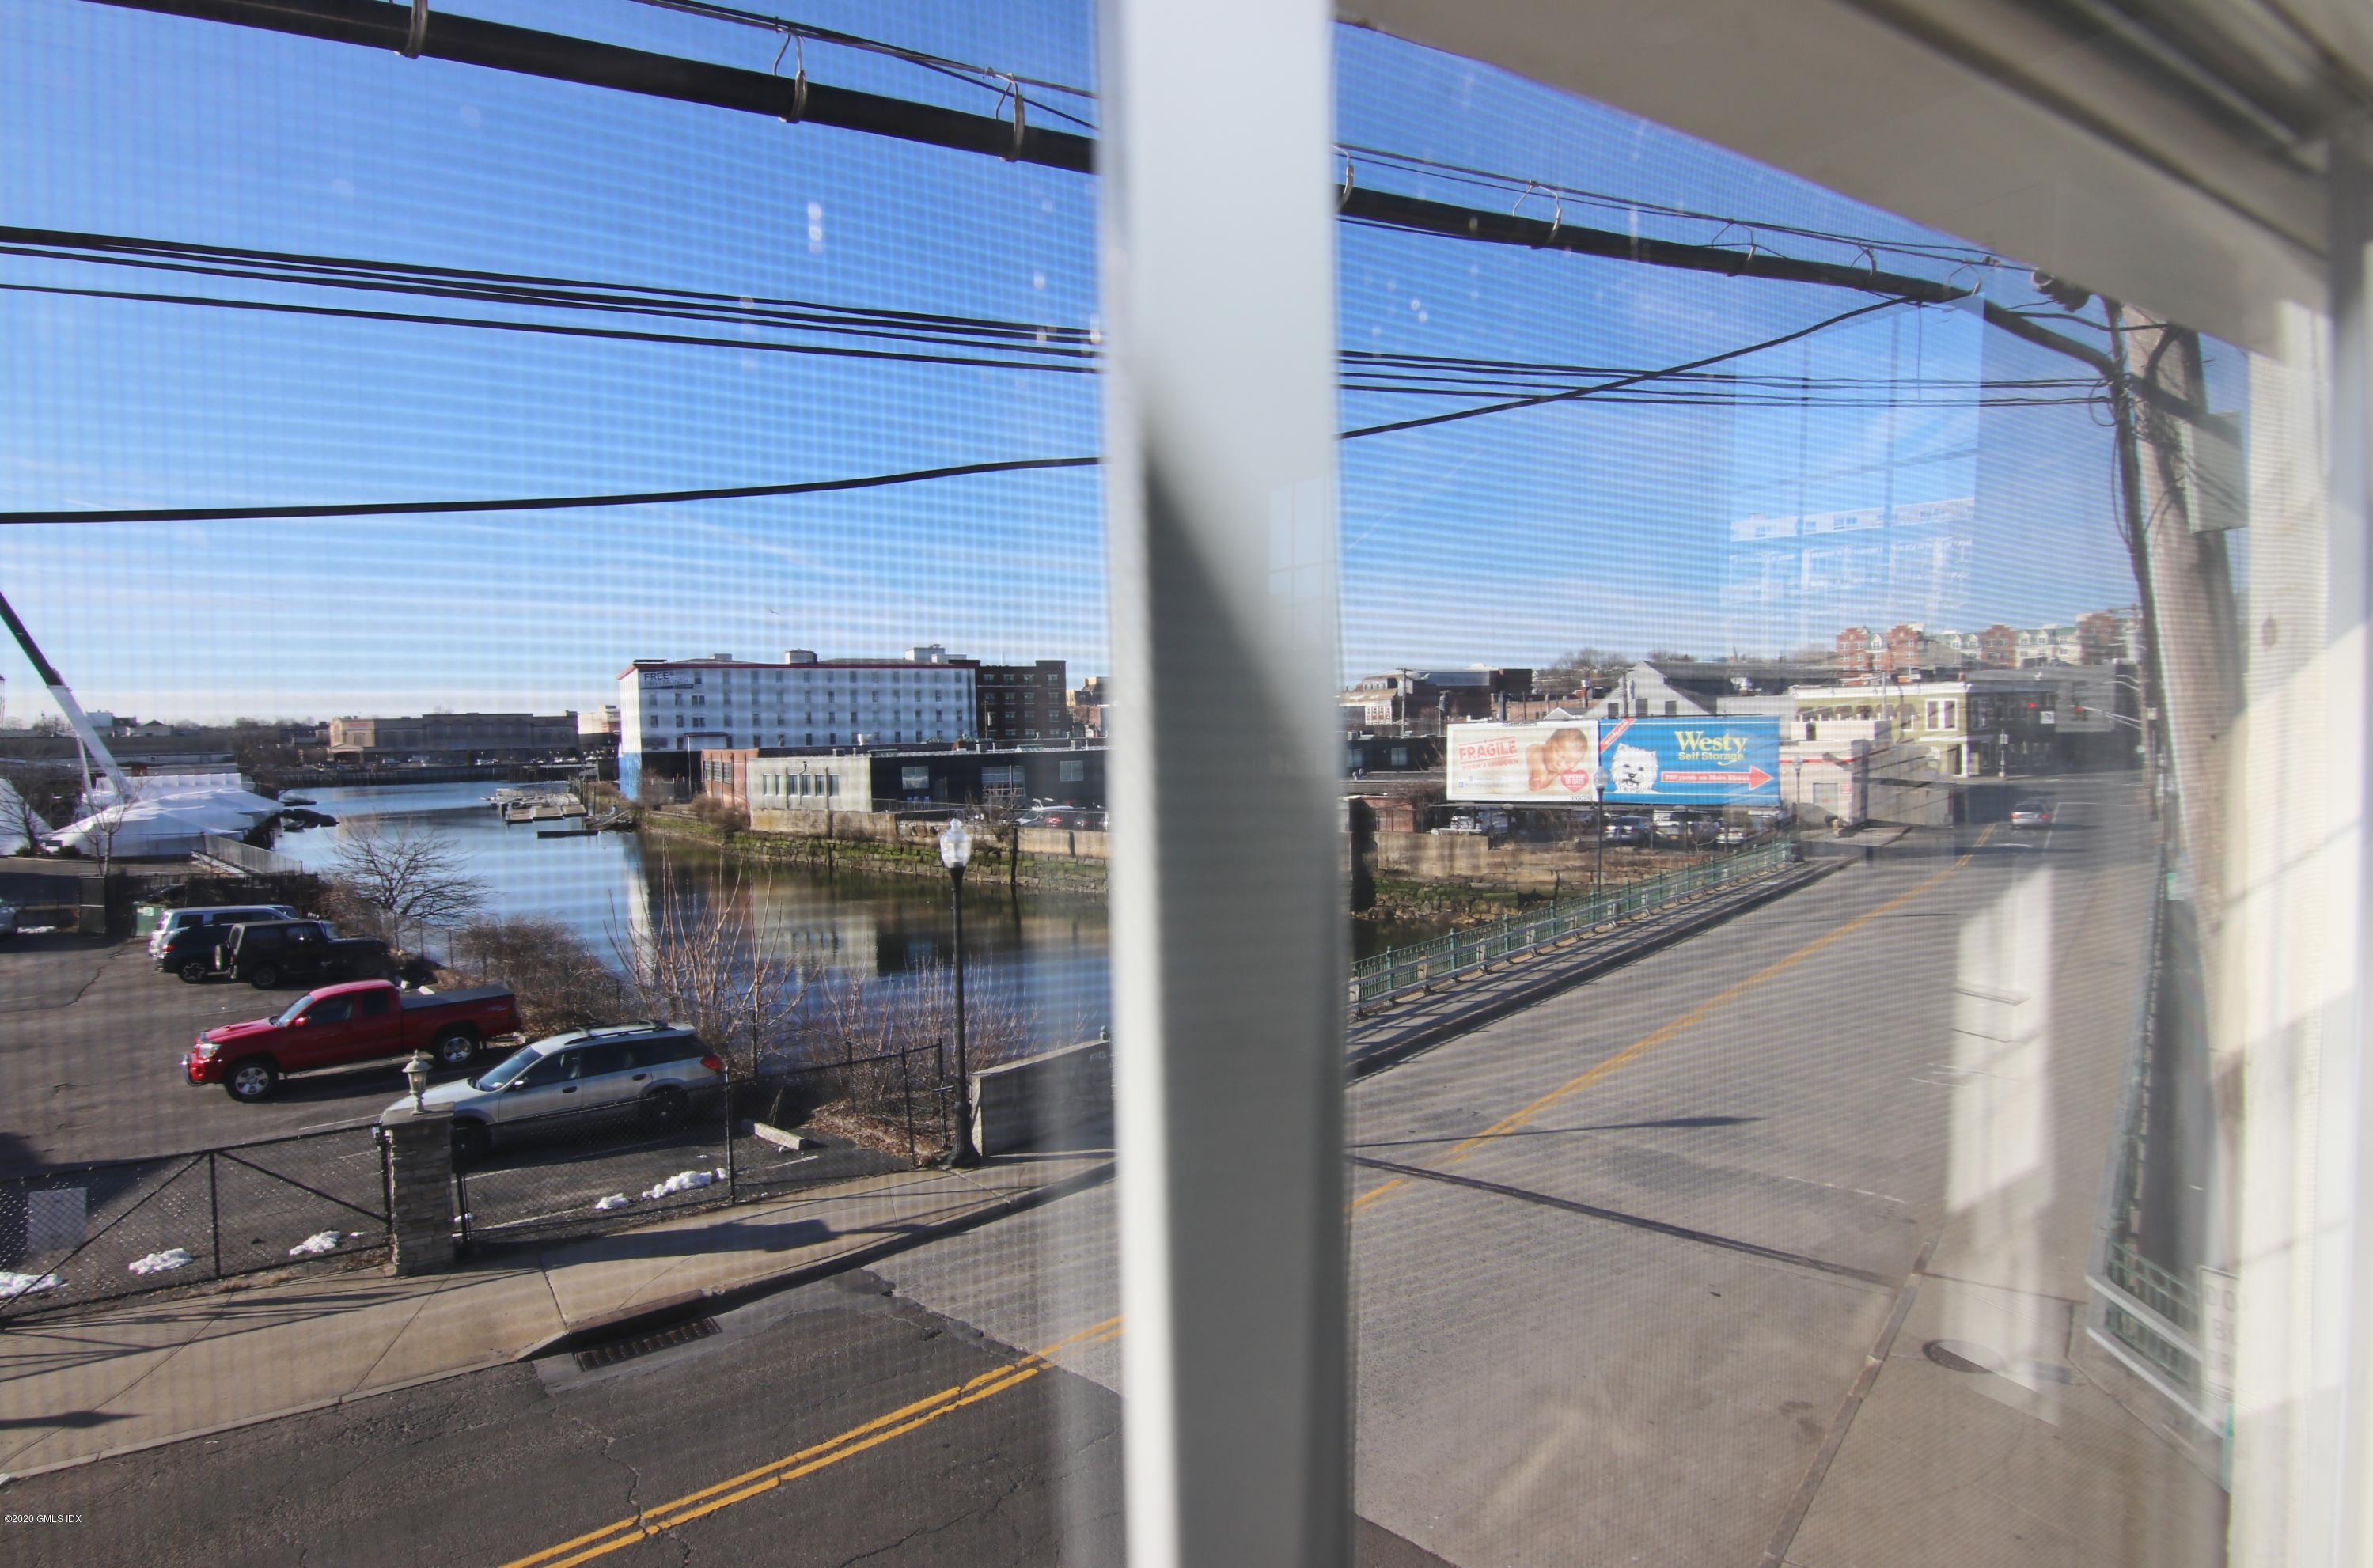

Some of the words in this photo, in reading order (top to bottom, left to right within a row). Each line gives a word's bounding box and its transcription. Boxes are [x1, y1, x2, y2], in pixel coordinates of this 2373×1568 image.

[644, 672, 669, 680] FREE
[1458, 740, 1518, 760] FRAGILE
[1674, 730, 1748, 764] Westy
[1678, 752, 1700, 761] Self
[1702, 752, 1744, 763] Storage
